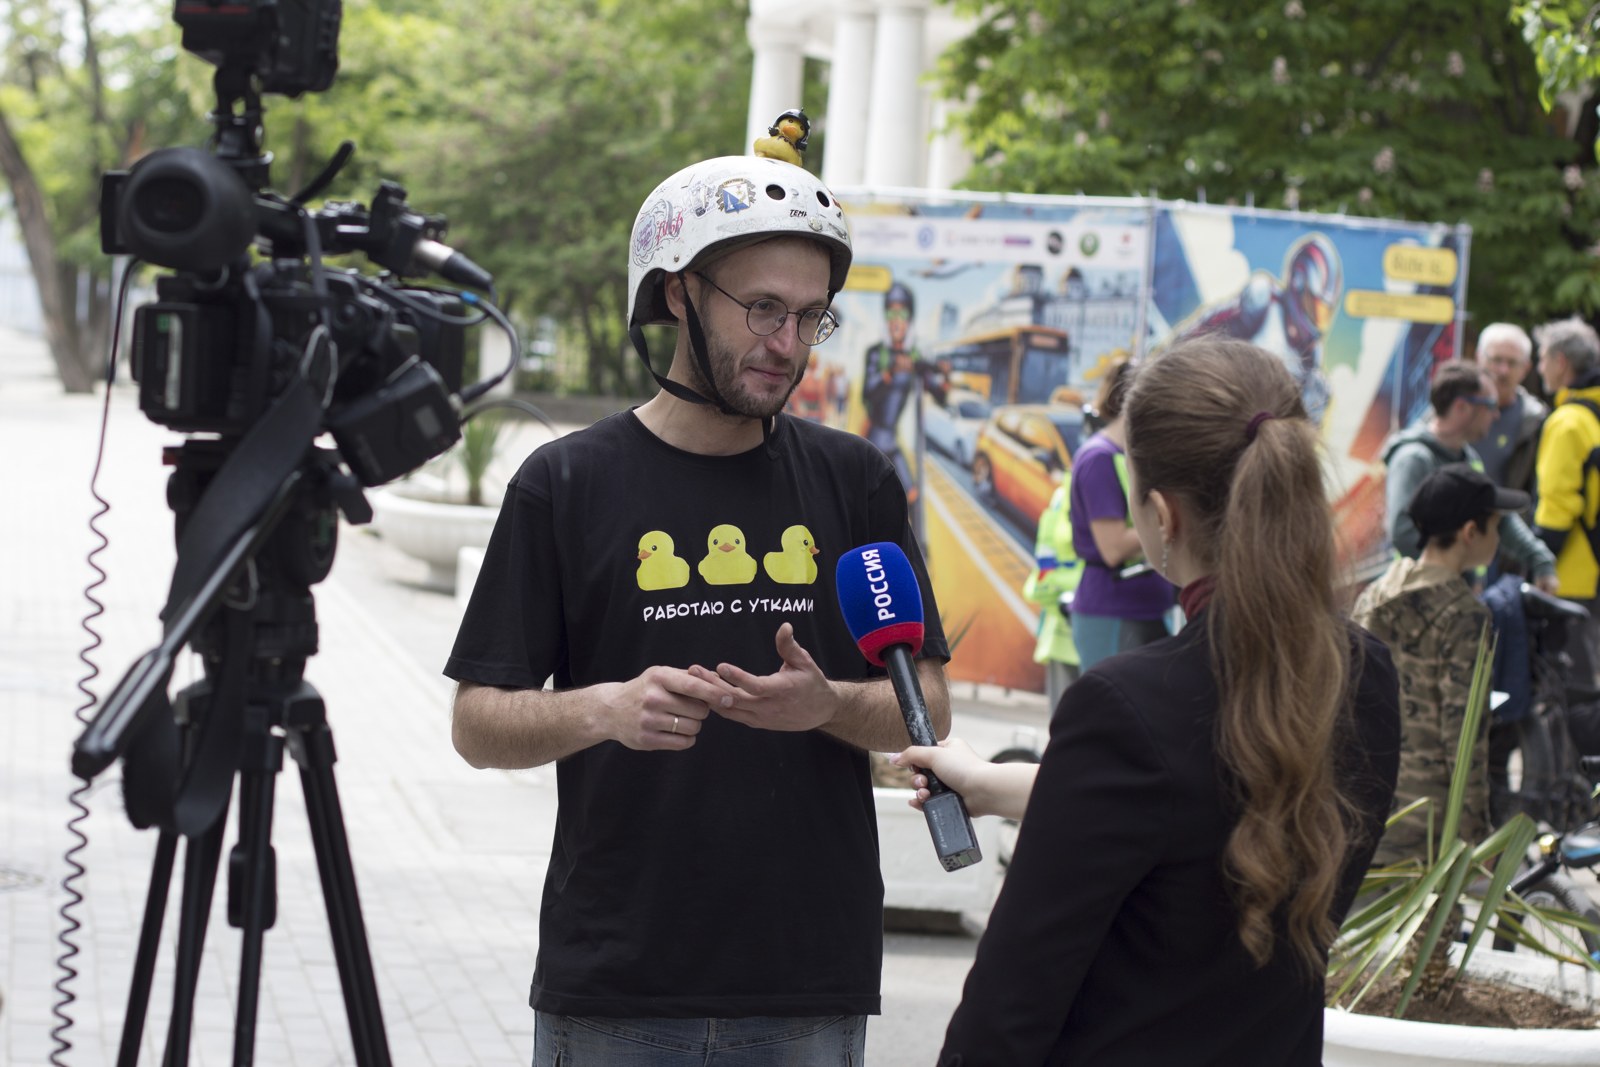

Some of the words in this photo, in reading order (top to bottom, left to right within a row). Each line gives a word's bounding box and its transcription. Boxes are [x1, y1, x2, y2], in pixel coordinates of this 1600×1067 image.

[861, 549, 896, 621] РОССИЯ
[643, 601, 724, 622] РАБОТАЮ
[730, 599, 743, 613] С
[749, 598, 814, 613] УТКАМИ
